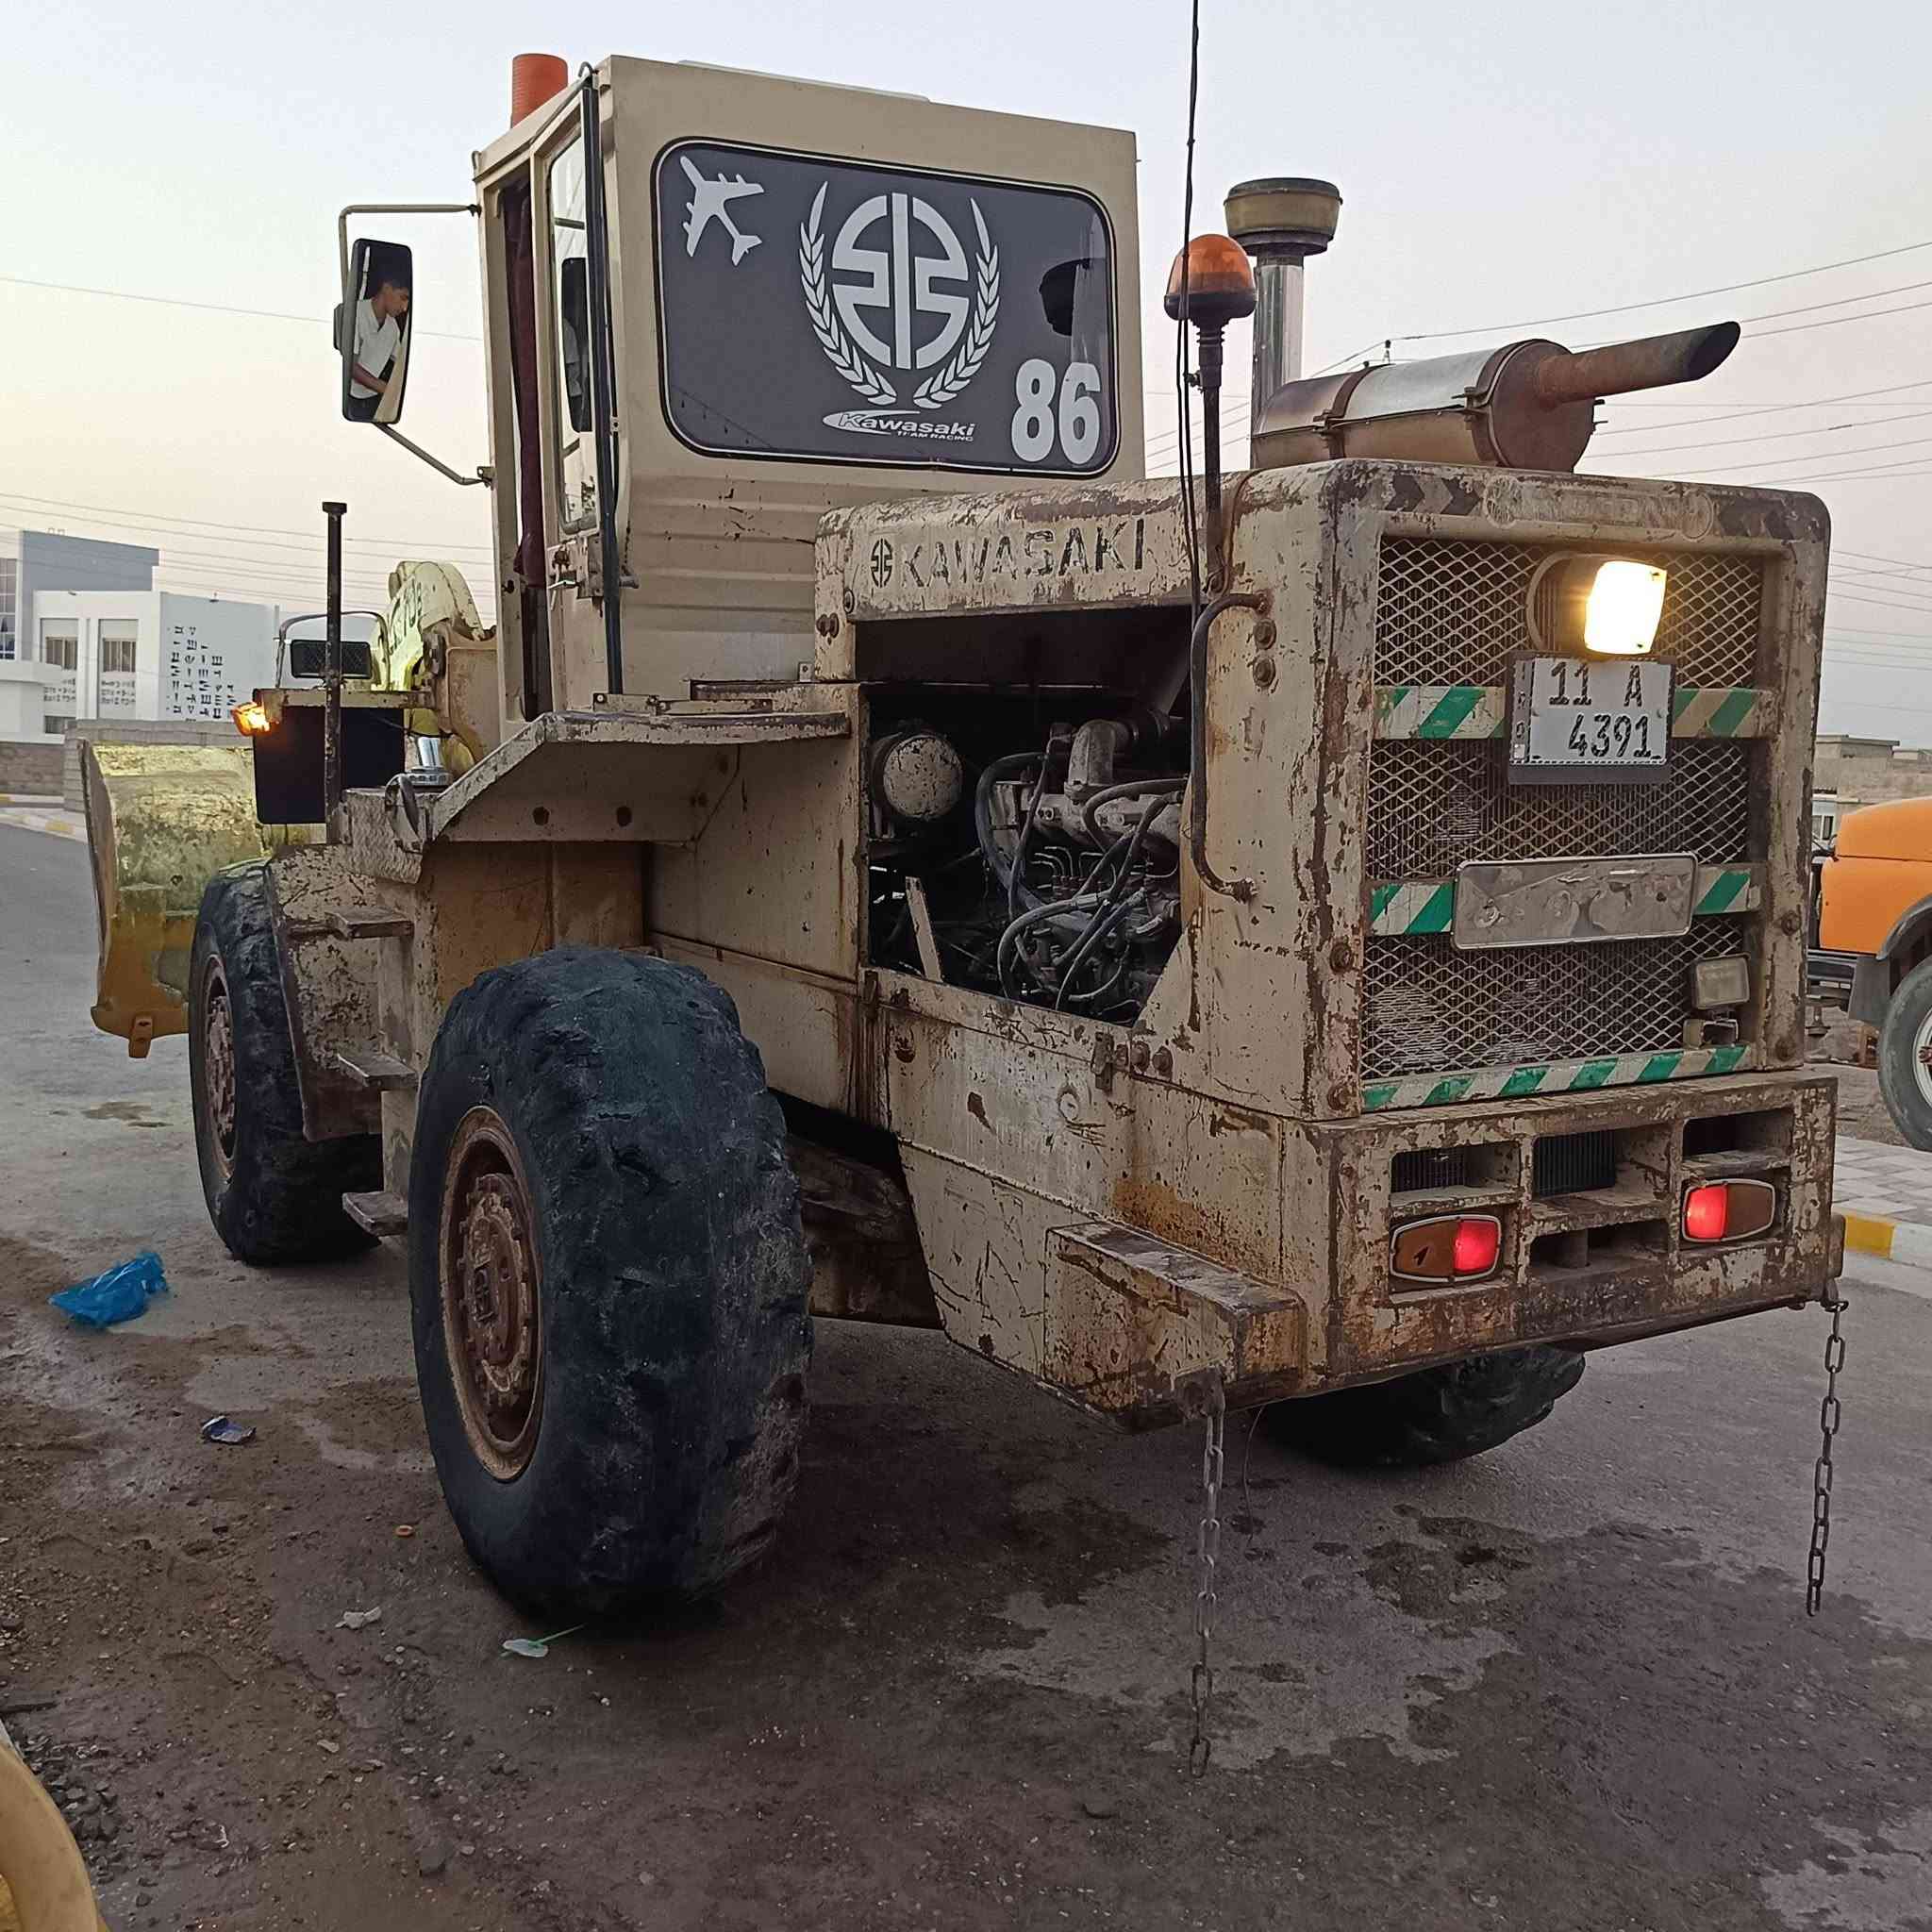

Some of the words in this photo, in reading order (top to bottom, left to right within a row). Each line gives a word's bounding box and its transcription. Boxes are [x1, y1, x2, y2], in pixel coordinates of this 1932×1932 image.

[839, 413, 975, 436] Kawasaki
[1011, 358, 1102, 465] 86
[903, 518, 1145, 589] KAWASAKI
[1548, 661, 1592, 706] 11
[1624, 664, 1643, 708] A
[1567, 713, 1652, 758] 4391
